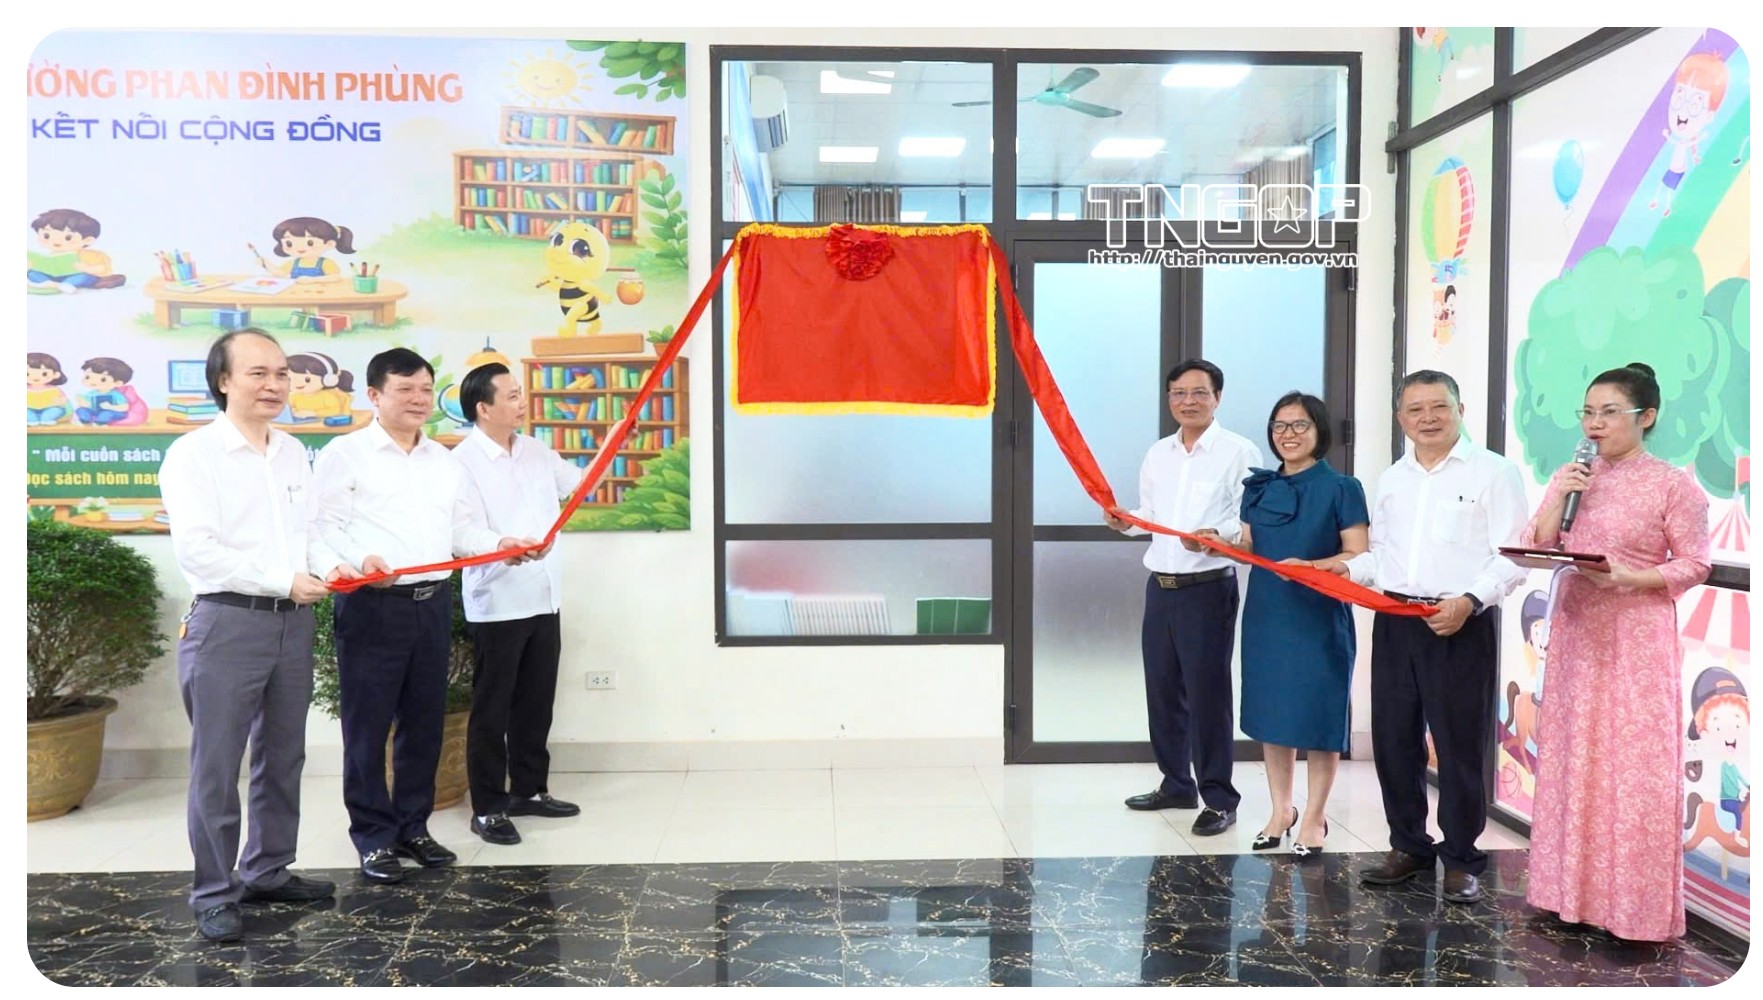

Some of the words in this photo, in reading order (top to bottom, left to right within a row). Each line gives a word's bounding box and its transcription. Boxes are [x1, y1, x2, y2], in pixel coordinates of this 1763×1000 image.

[125, 69, 229, 99] PHAN
[238, 62, 325, 100] ĐÌNH
[335, 64, 463, 102] PHÙNG
[32, 111, 99, 138] KẾT
[112, 112, 166, 139] NỐI
[180, 115, 274, 145] CỘNG
[287, 114, 381, 141] ĐỒNG
[80, 446, 118, 462] cuốn
[123, 447, 160, 462] sách
[55, 471, 91, 485] sách
[97, 471, 128, 485] hôm
